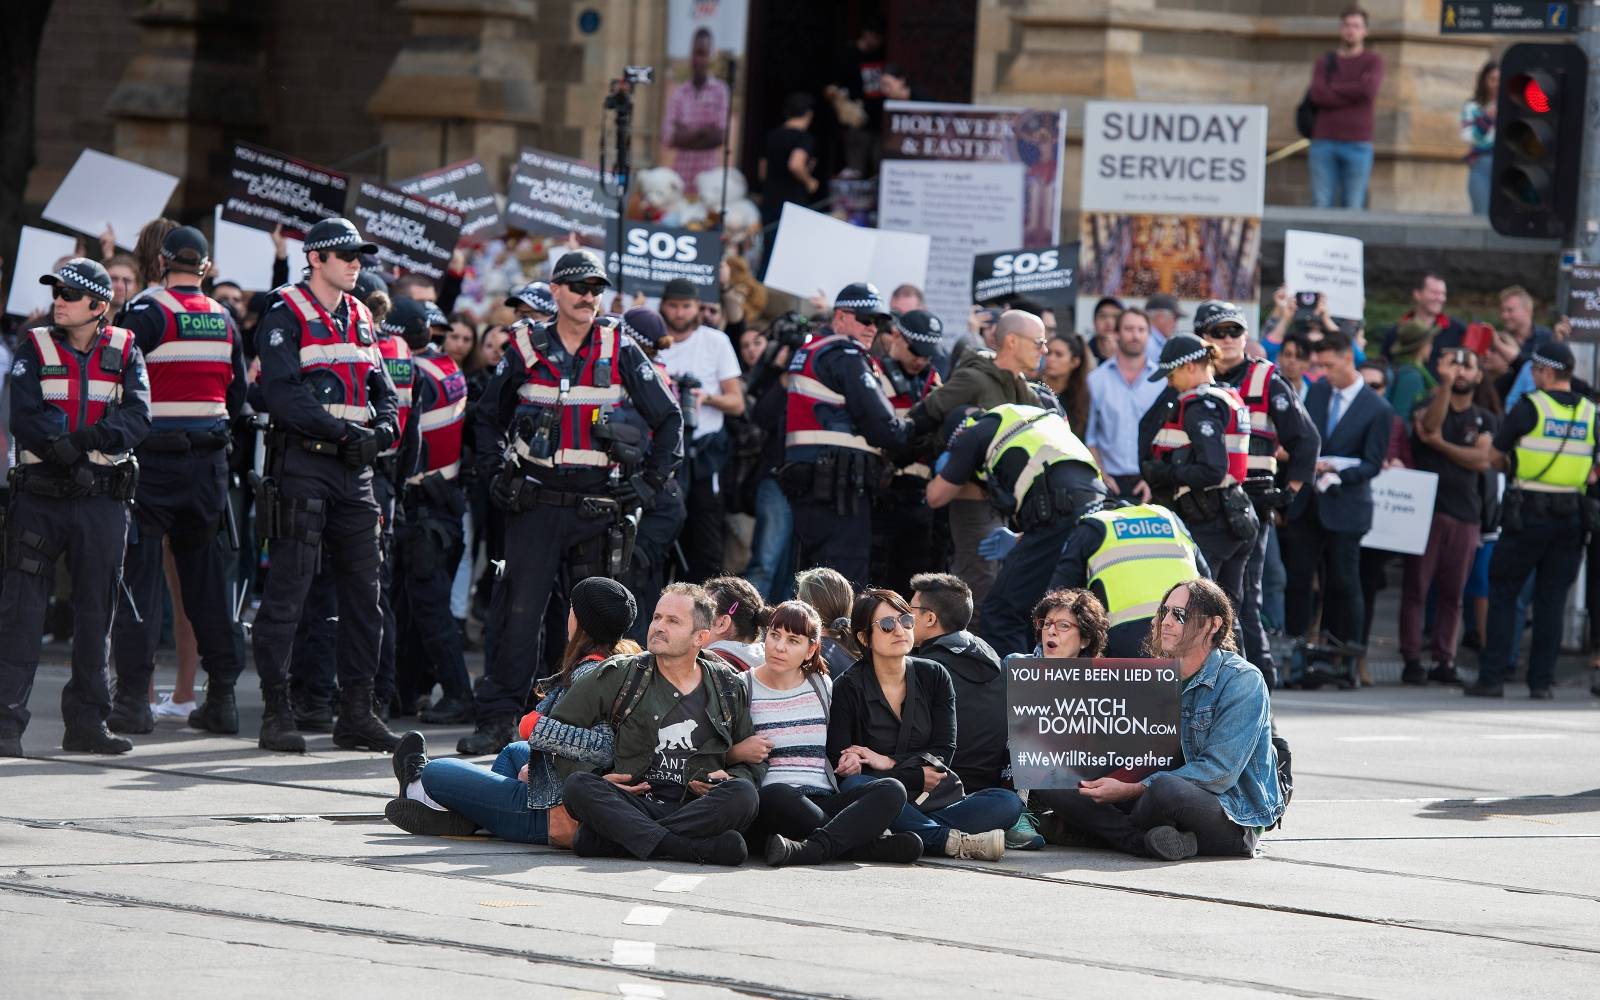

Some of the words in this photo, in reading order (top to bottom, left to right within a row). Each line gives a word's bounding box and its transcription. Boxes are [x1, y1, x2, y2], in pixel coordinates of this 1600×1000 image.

[891, 114, 948, 134] HOLY
[952, 118, 1015, 137] WEEK
[1102, 112, 1247, 144] SUNDAY
[901, 138, 917, 155] &
[922, 139, 1003, 158] EASTER
[235, 146, 258, 162] YOU
[257, 152, 284, 170] HAVE
[283, 161, 310, 179] BEEN
[521, 152, 543, 167] YOU
[543, 159, 569, 174] HAVE
[568, 164, 594, 180] BEEN
[1099, 154, 1247, 182] SERVICES
[627, 228, 698, 262] SOS
[650, 259, 714, 275] EMERGENCY
[992, 249, 1059, 278] SOS
[1013, 268, 1073, 283] EMERGENCY
[1013, 277, 1073, 293] EMERGENCY
[180, 314, 226, 330] Police
[389, 361, 411, 374] lice
[1115, 521, 1173, 537] Police
[1011, 668, 1040, 681] YOU
[1044, 668, 1080, 681] HAVE
[1084, 669, 1120, 682] BEEN
[1124, 670, 1152, 682] LIED
[1156, 670, 1179, 682] TO.
[1038, 716, 1177, 735] DOMINION.COM
[1017, 750, 1174, 770] #WeWillRiseTogether
